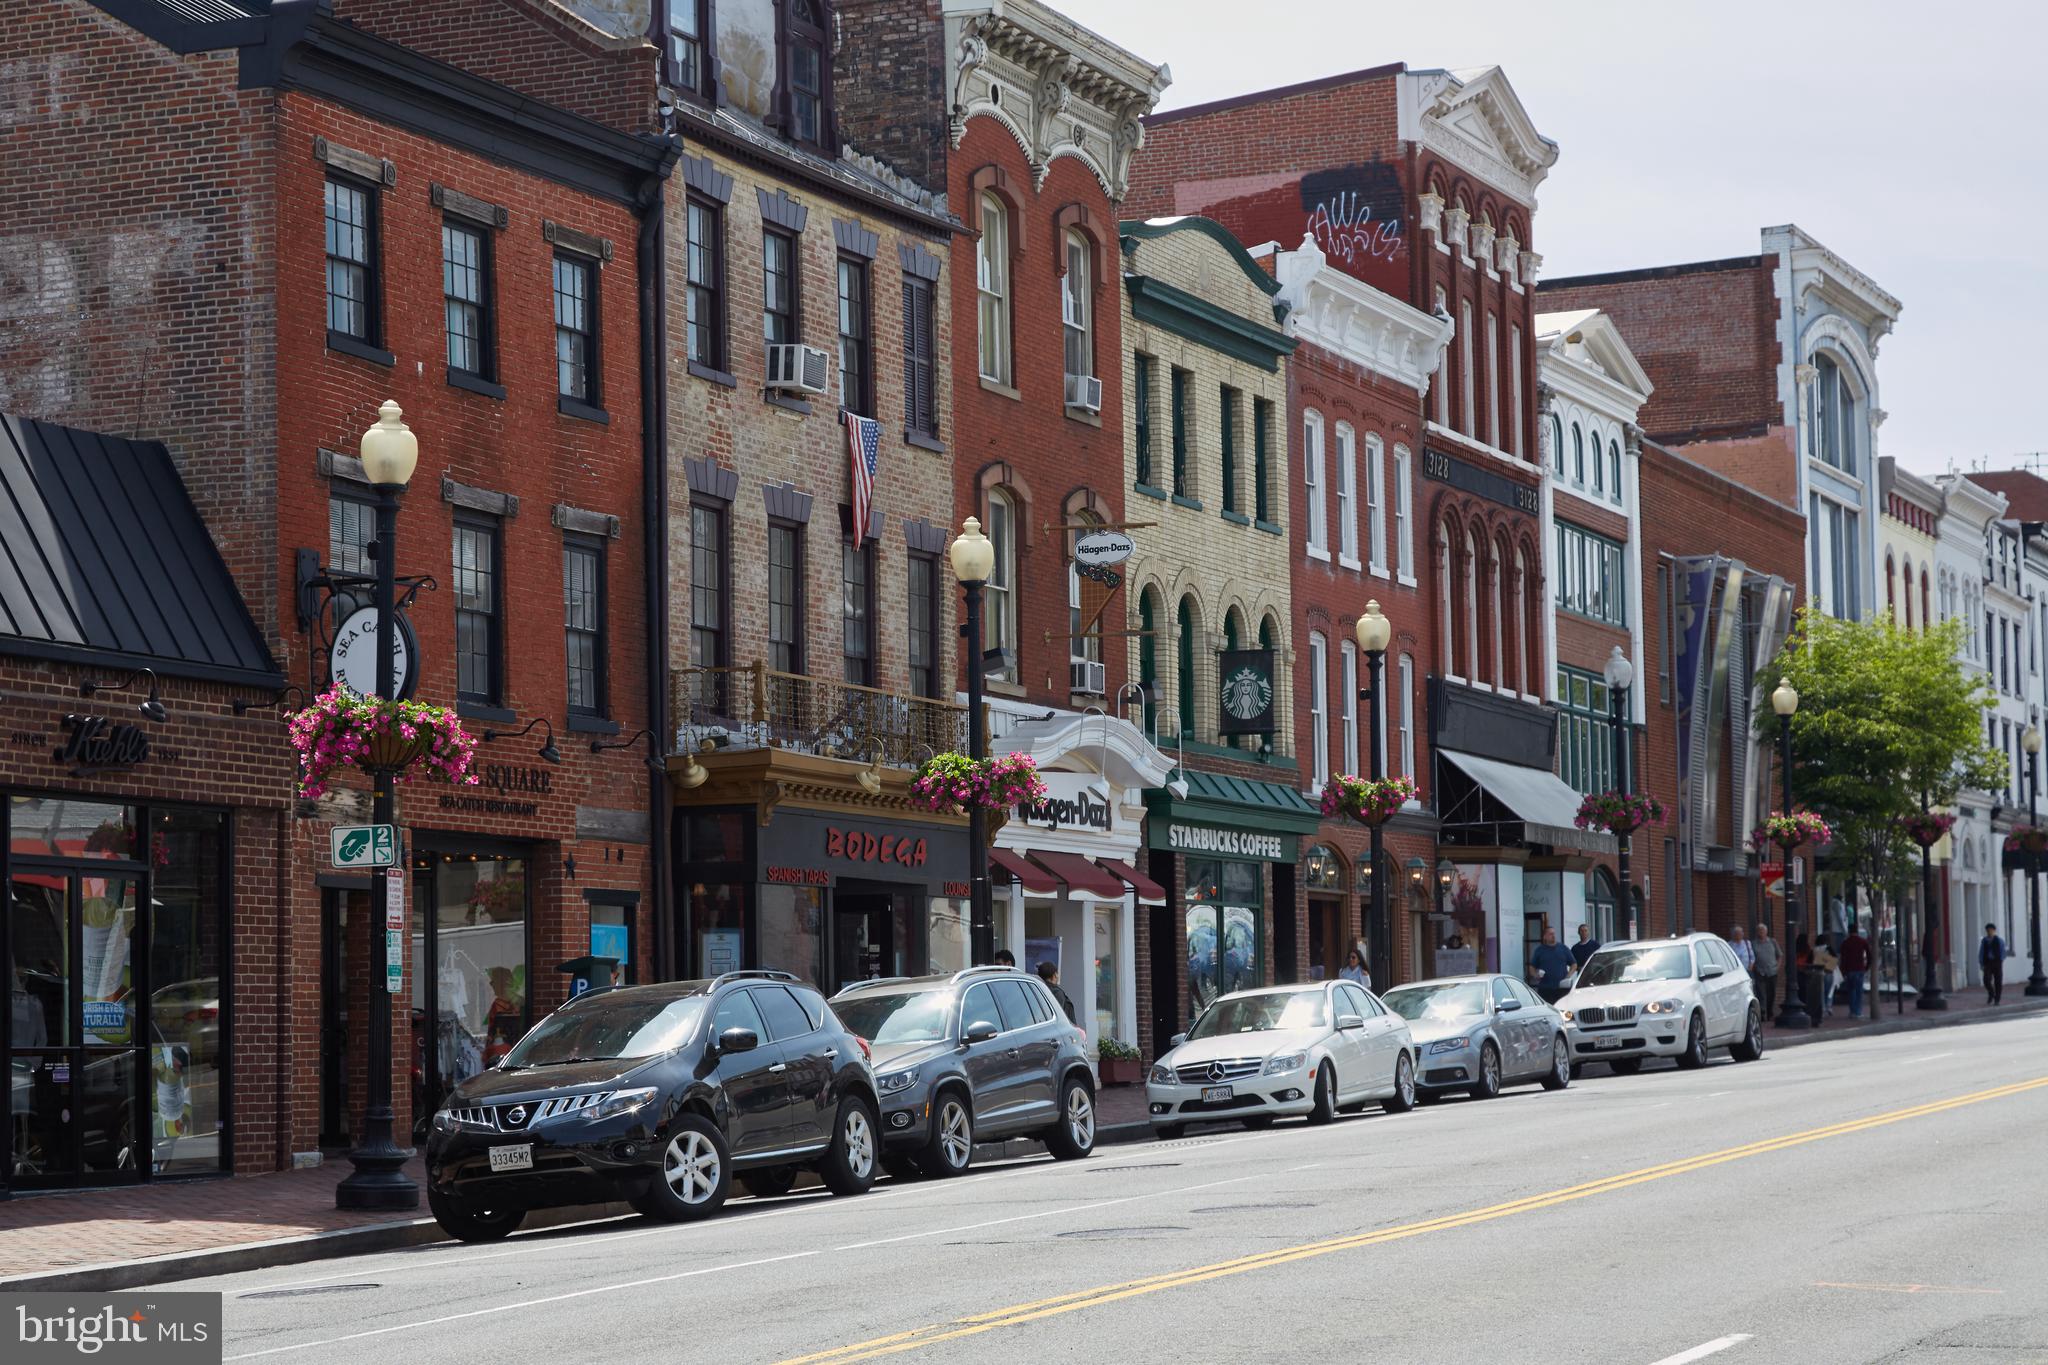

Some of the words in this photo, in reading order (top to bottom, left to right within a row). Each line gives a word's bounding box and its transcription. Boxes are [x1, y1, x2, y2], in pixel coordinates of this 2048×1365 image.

[1428, 453, 1449, 479] 3128
[1519, 488, 1538, 512] 3128
[1078, 543, 1130, 555] Häagen-Dazs
[337, 630, 359, 658] SEA
[486, 764, 551, 796] SQUARE
[377, 827, 390, 843] 2
[826, 826, 928, 867] BODEGA
[1168, 824, 1240, 854] STARBUCKS
[1240, 833, 1282, 858] COFFEE
[767, 866, 802, 882] SPANISH
[803, 869, 829, 885] TAPAS
[576, 978, 588, 996] P
[491, 1151, 529, 1166] 33345M2
